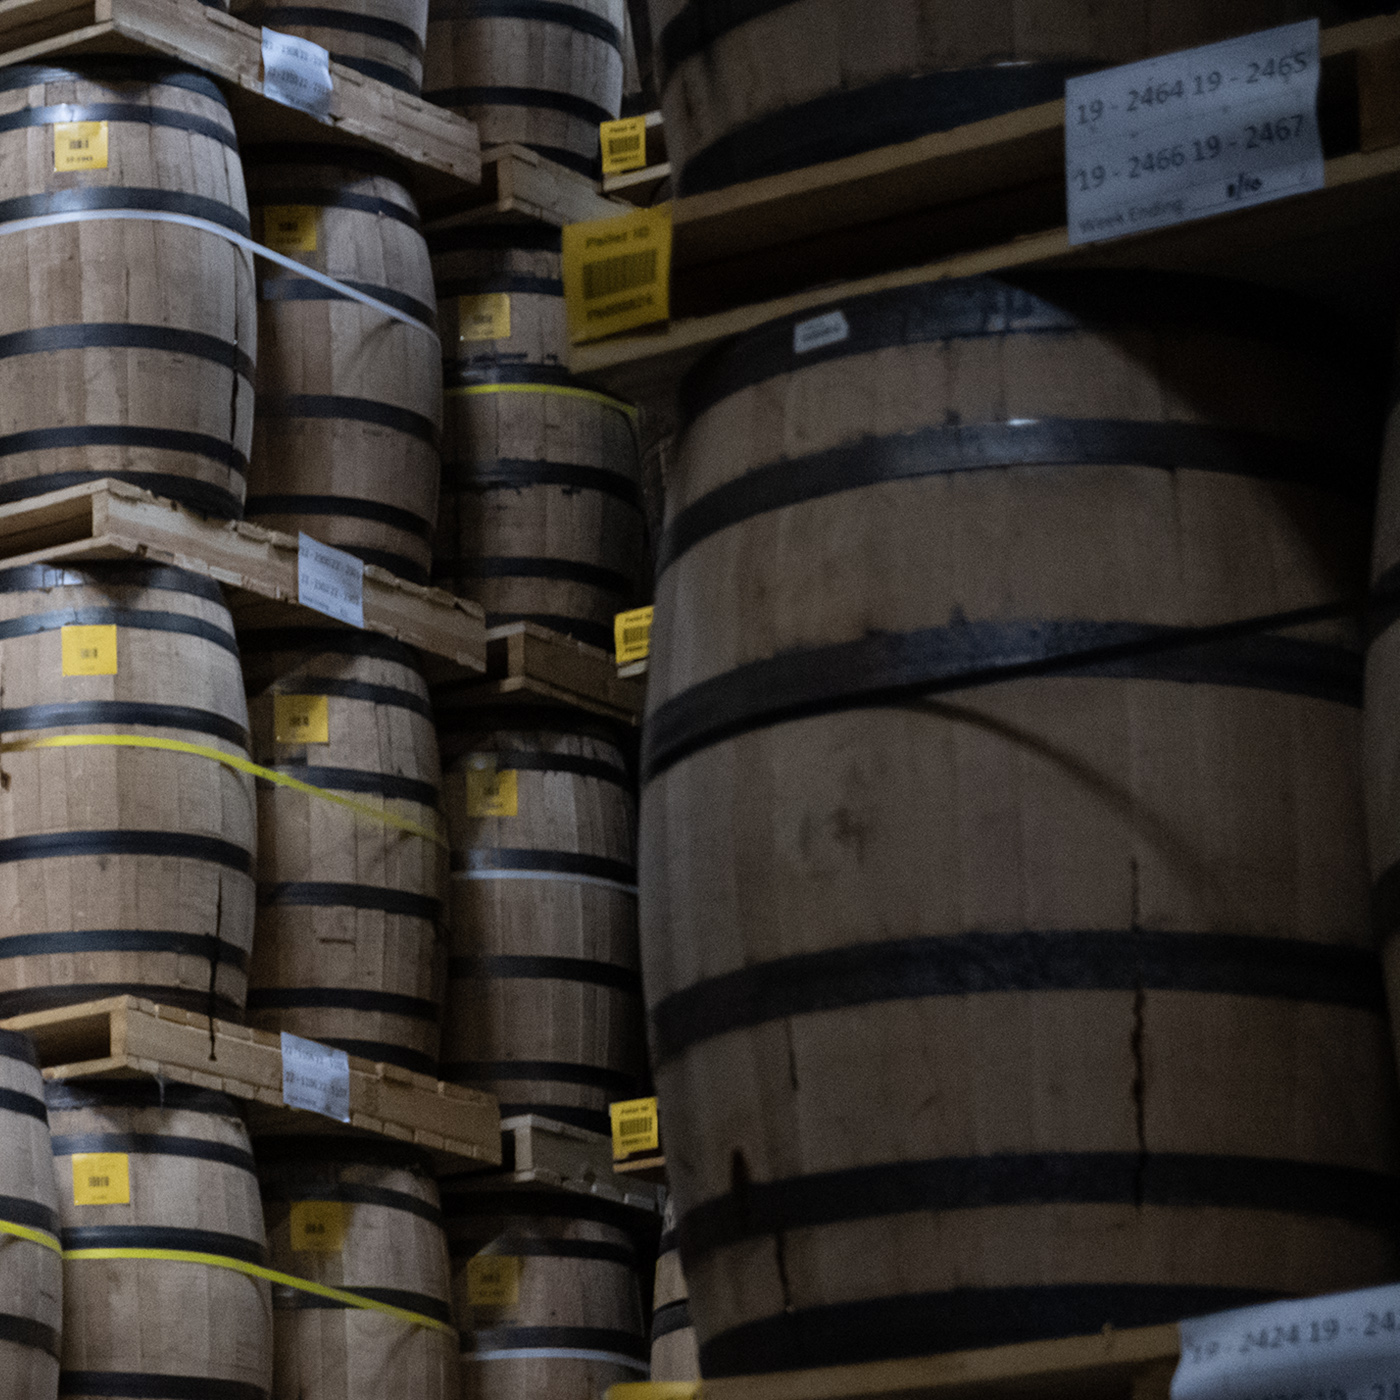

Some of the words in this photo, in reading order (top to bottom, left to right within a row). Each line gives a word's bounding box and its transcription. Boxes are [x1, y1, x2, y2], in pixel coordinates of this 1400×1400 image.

[1077, 99, 1104, 126] 19
[1125, 80, 1184, 113] 2464
[1192, 72, 1222, 96] 19
[1245, 51, 1308, 84] 2465
[1076, 165, 1107, 192] 19
[1128, 145, 1185, 180] 2466
[1192, 135, 1222, 162] 19
[1244, 113, 1304, 150] 2467
[1239, 1325, 1300, 1352] 2424
[1310, 1319, 1339, 1343] 19
[1363, 1311, 1400, 1336] 24
